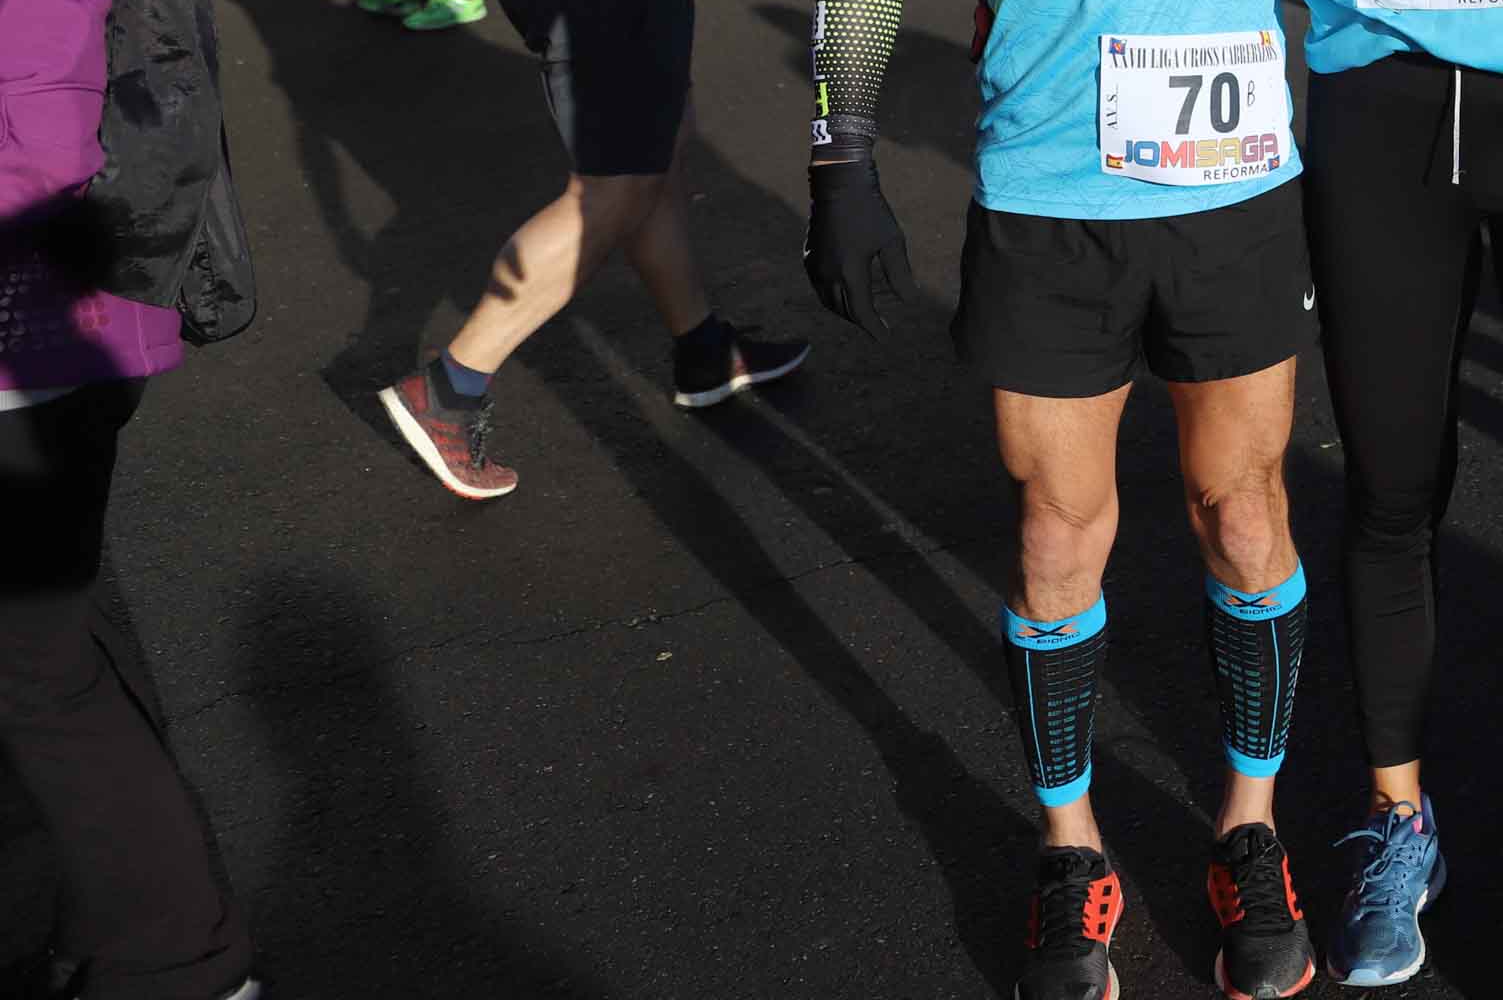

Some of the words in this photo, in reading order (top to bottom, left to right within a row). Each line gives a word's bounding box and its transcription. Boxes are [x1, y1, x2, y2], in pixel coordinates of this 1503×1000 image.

[1151, 46, 1180, 69] LIGA
[1183, 45, 1221, 68] CROSS
[1168, 71, 1241, 135] 70
[1124, 132, 1279, 169] JOMISAGA
[1203, 165, 1271, 181] REFORMA
